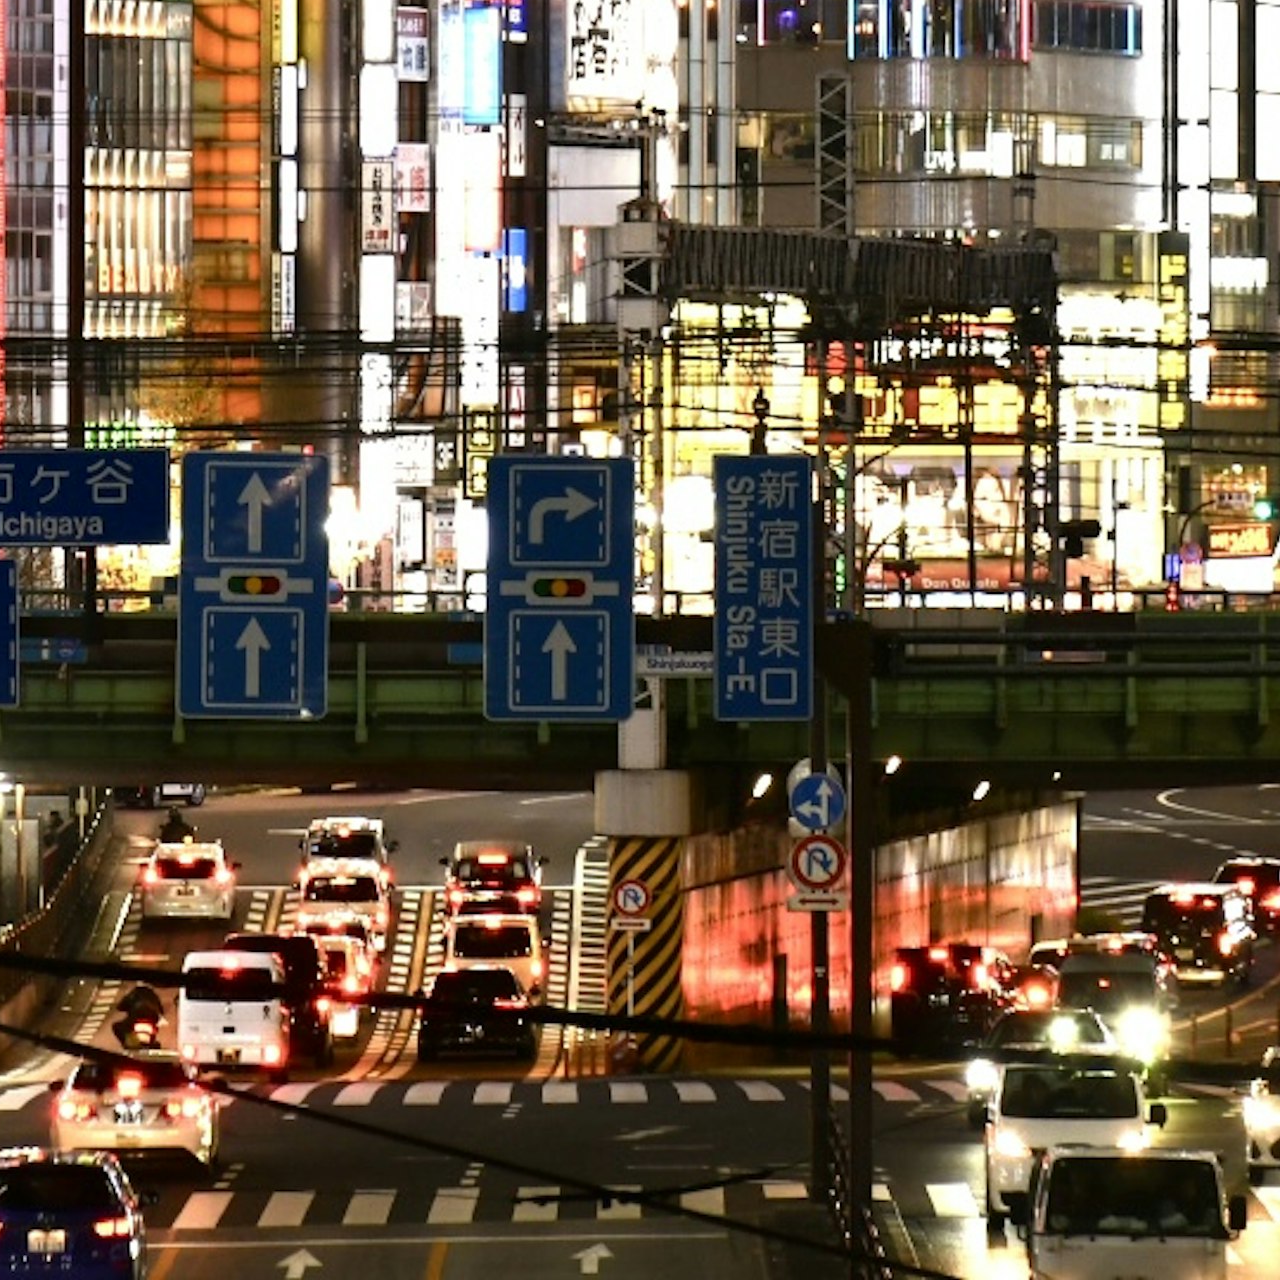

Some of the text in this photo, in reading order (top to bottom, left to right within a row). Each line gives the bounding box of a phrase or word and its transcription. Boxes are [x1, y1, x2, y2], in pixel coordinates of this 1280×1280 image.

[98, 264, 179, 294] BEAUTY
[725, 475, 755, 595] Shinjuku
[757, 470, 800, 706] 新宿駅東口
